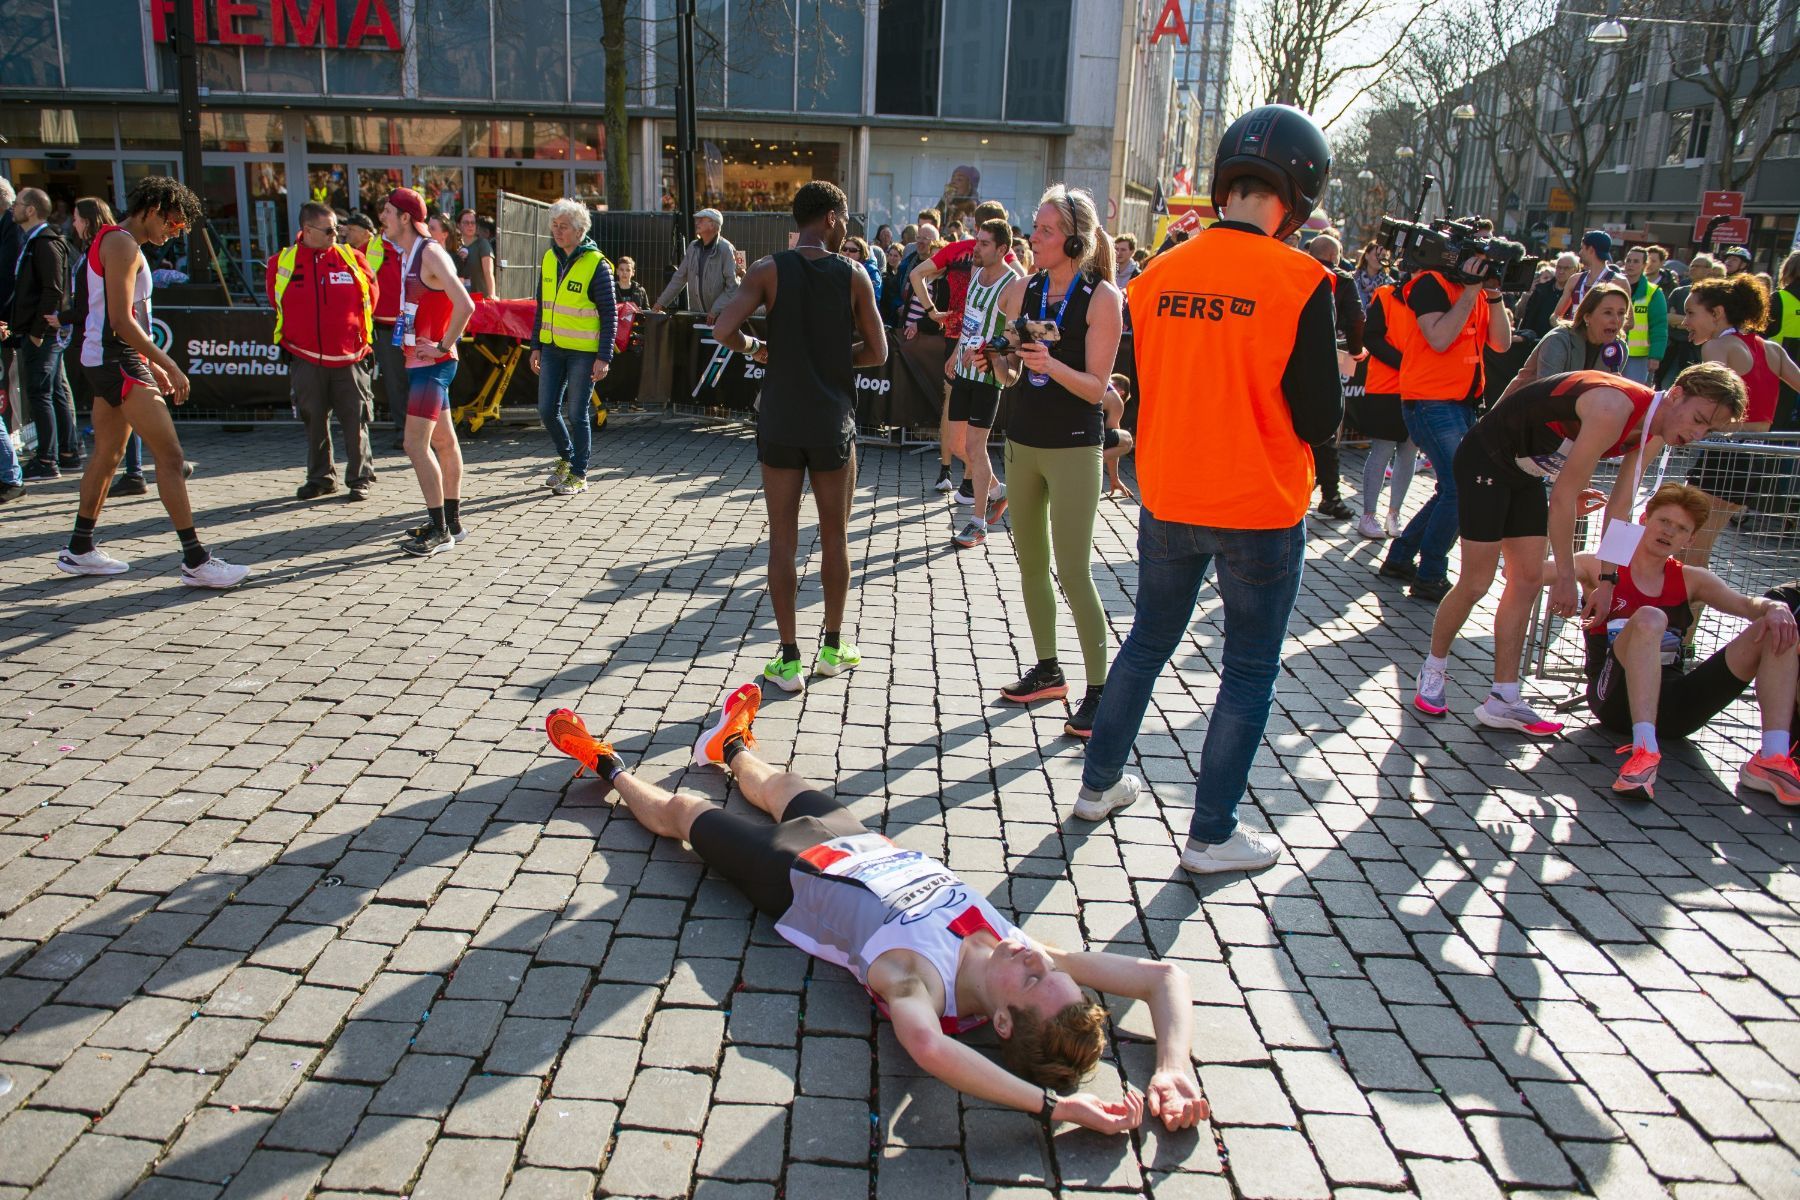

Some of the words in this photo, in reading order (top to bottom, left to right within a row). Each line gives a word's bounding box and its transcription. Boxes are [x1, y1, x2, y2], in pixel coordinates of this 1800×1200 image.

[1150, 0, 1189, 45] A
[1157, 294, 1226, 321] PERS
[1234, 301, 1252, 314] 7H
[187, 339, 281, 361] Stichting
